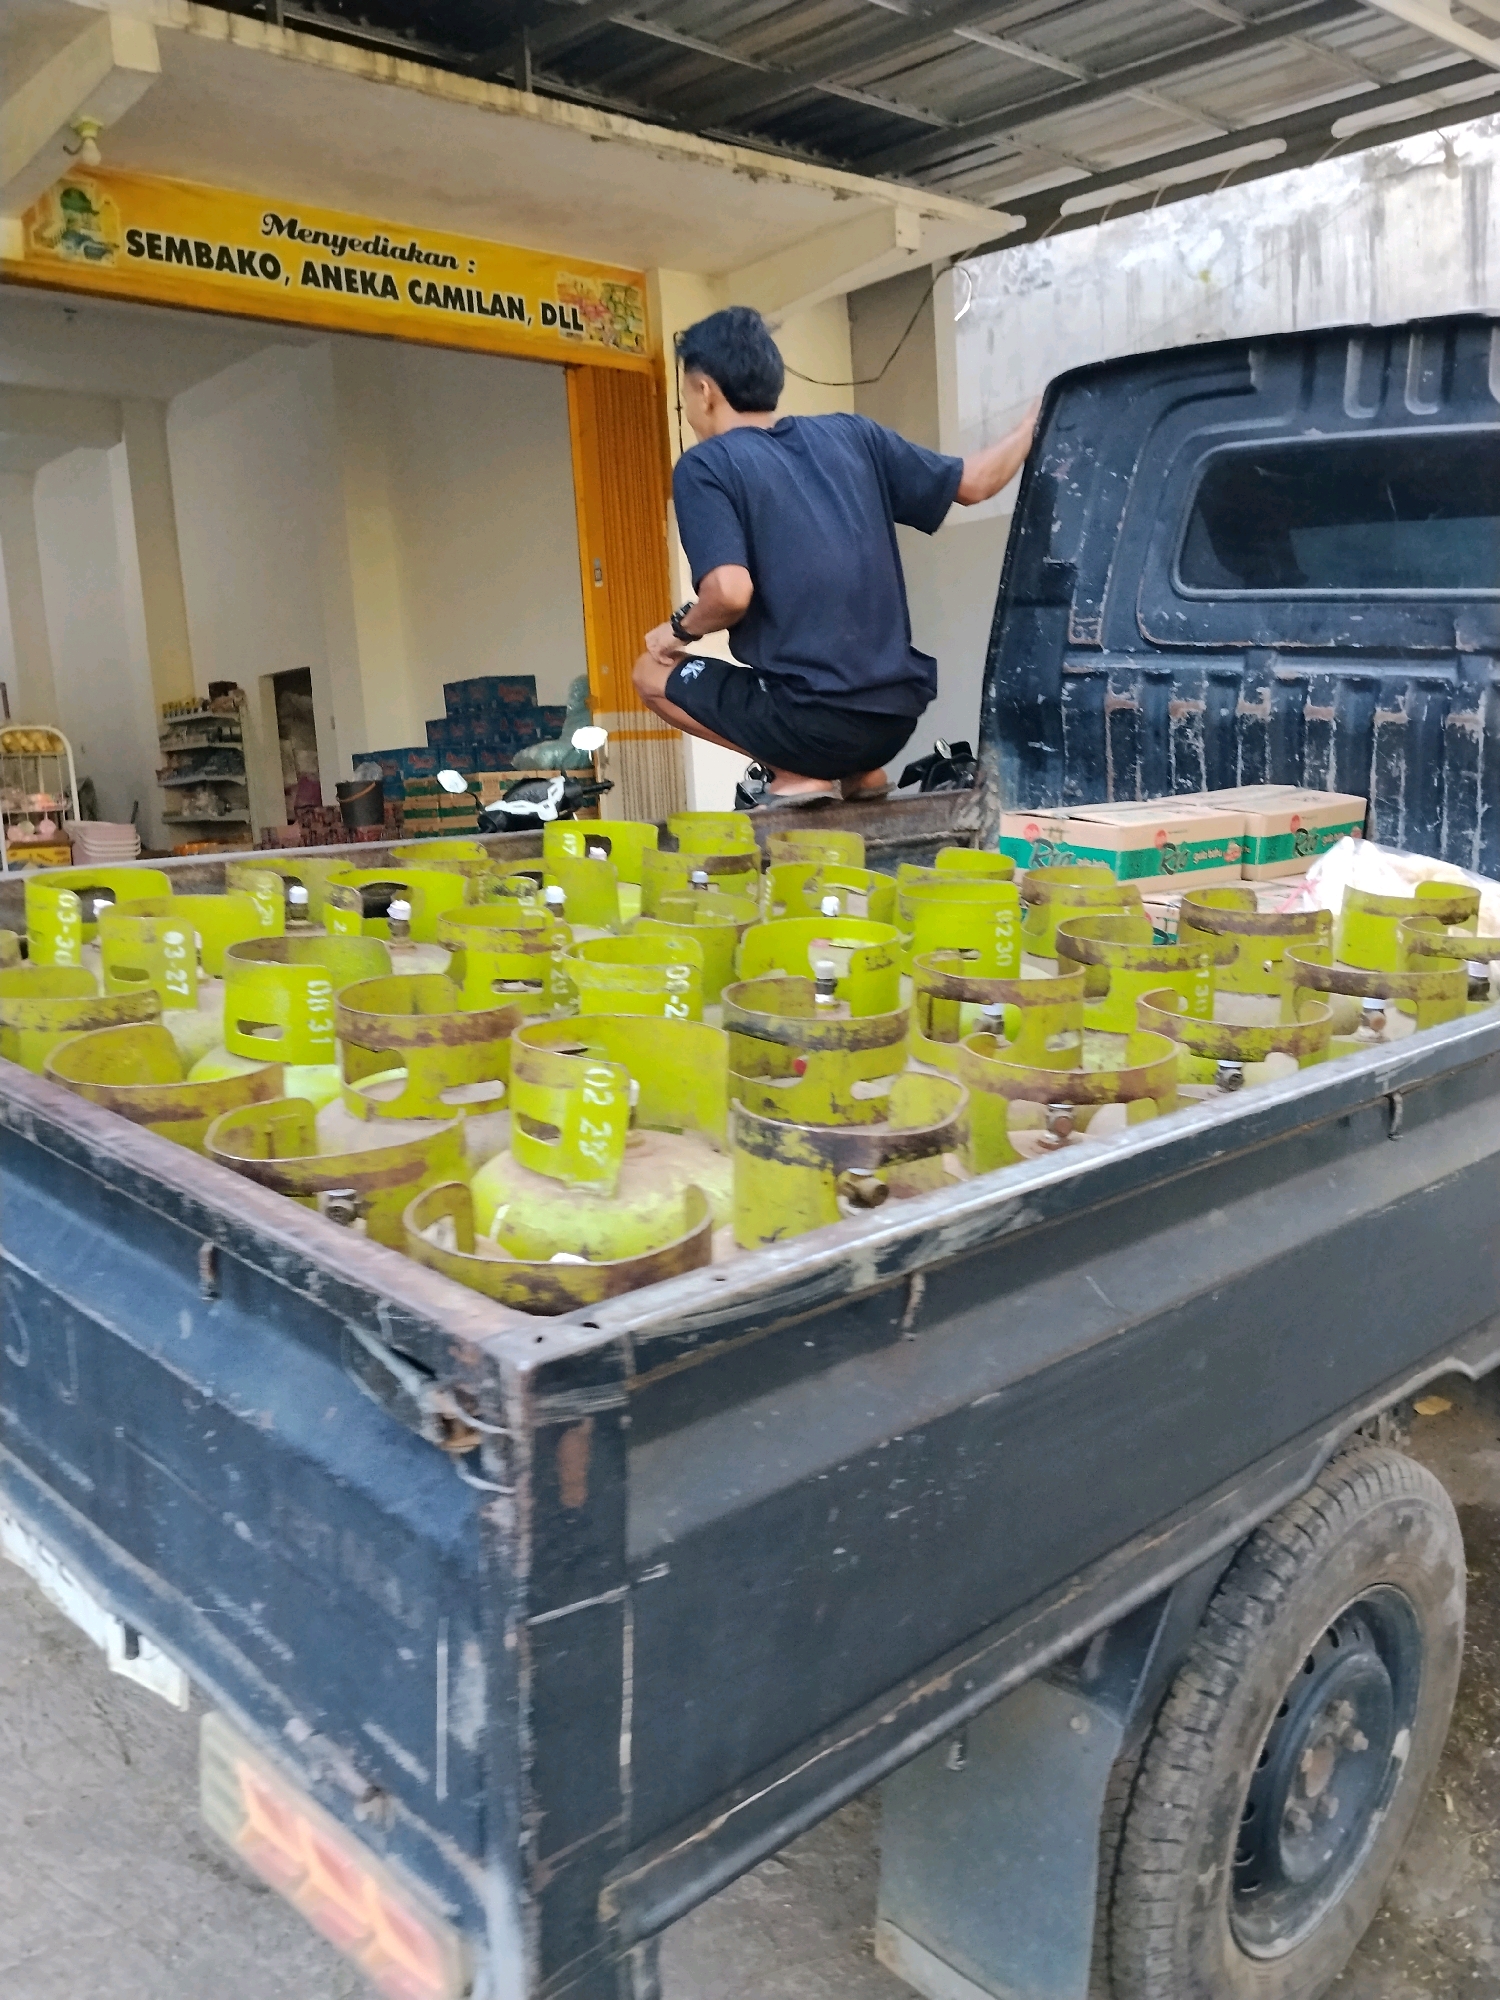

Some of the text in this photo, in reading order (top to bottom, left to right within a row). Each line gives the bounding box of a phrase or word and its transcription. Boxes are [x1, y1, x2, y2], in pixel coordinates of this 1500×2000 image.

[126, 228, 585, 332] SEMBAKO, ANEKA CAMILAN, DLL
[260, 213, 460, 270] Menyediakan
